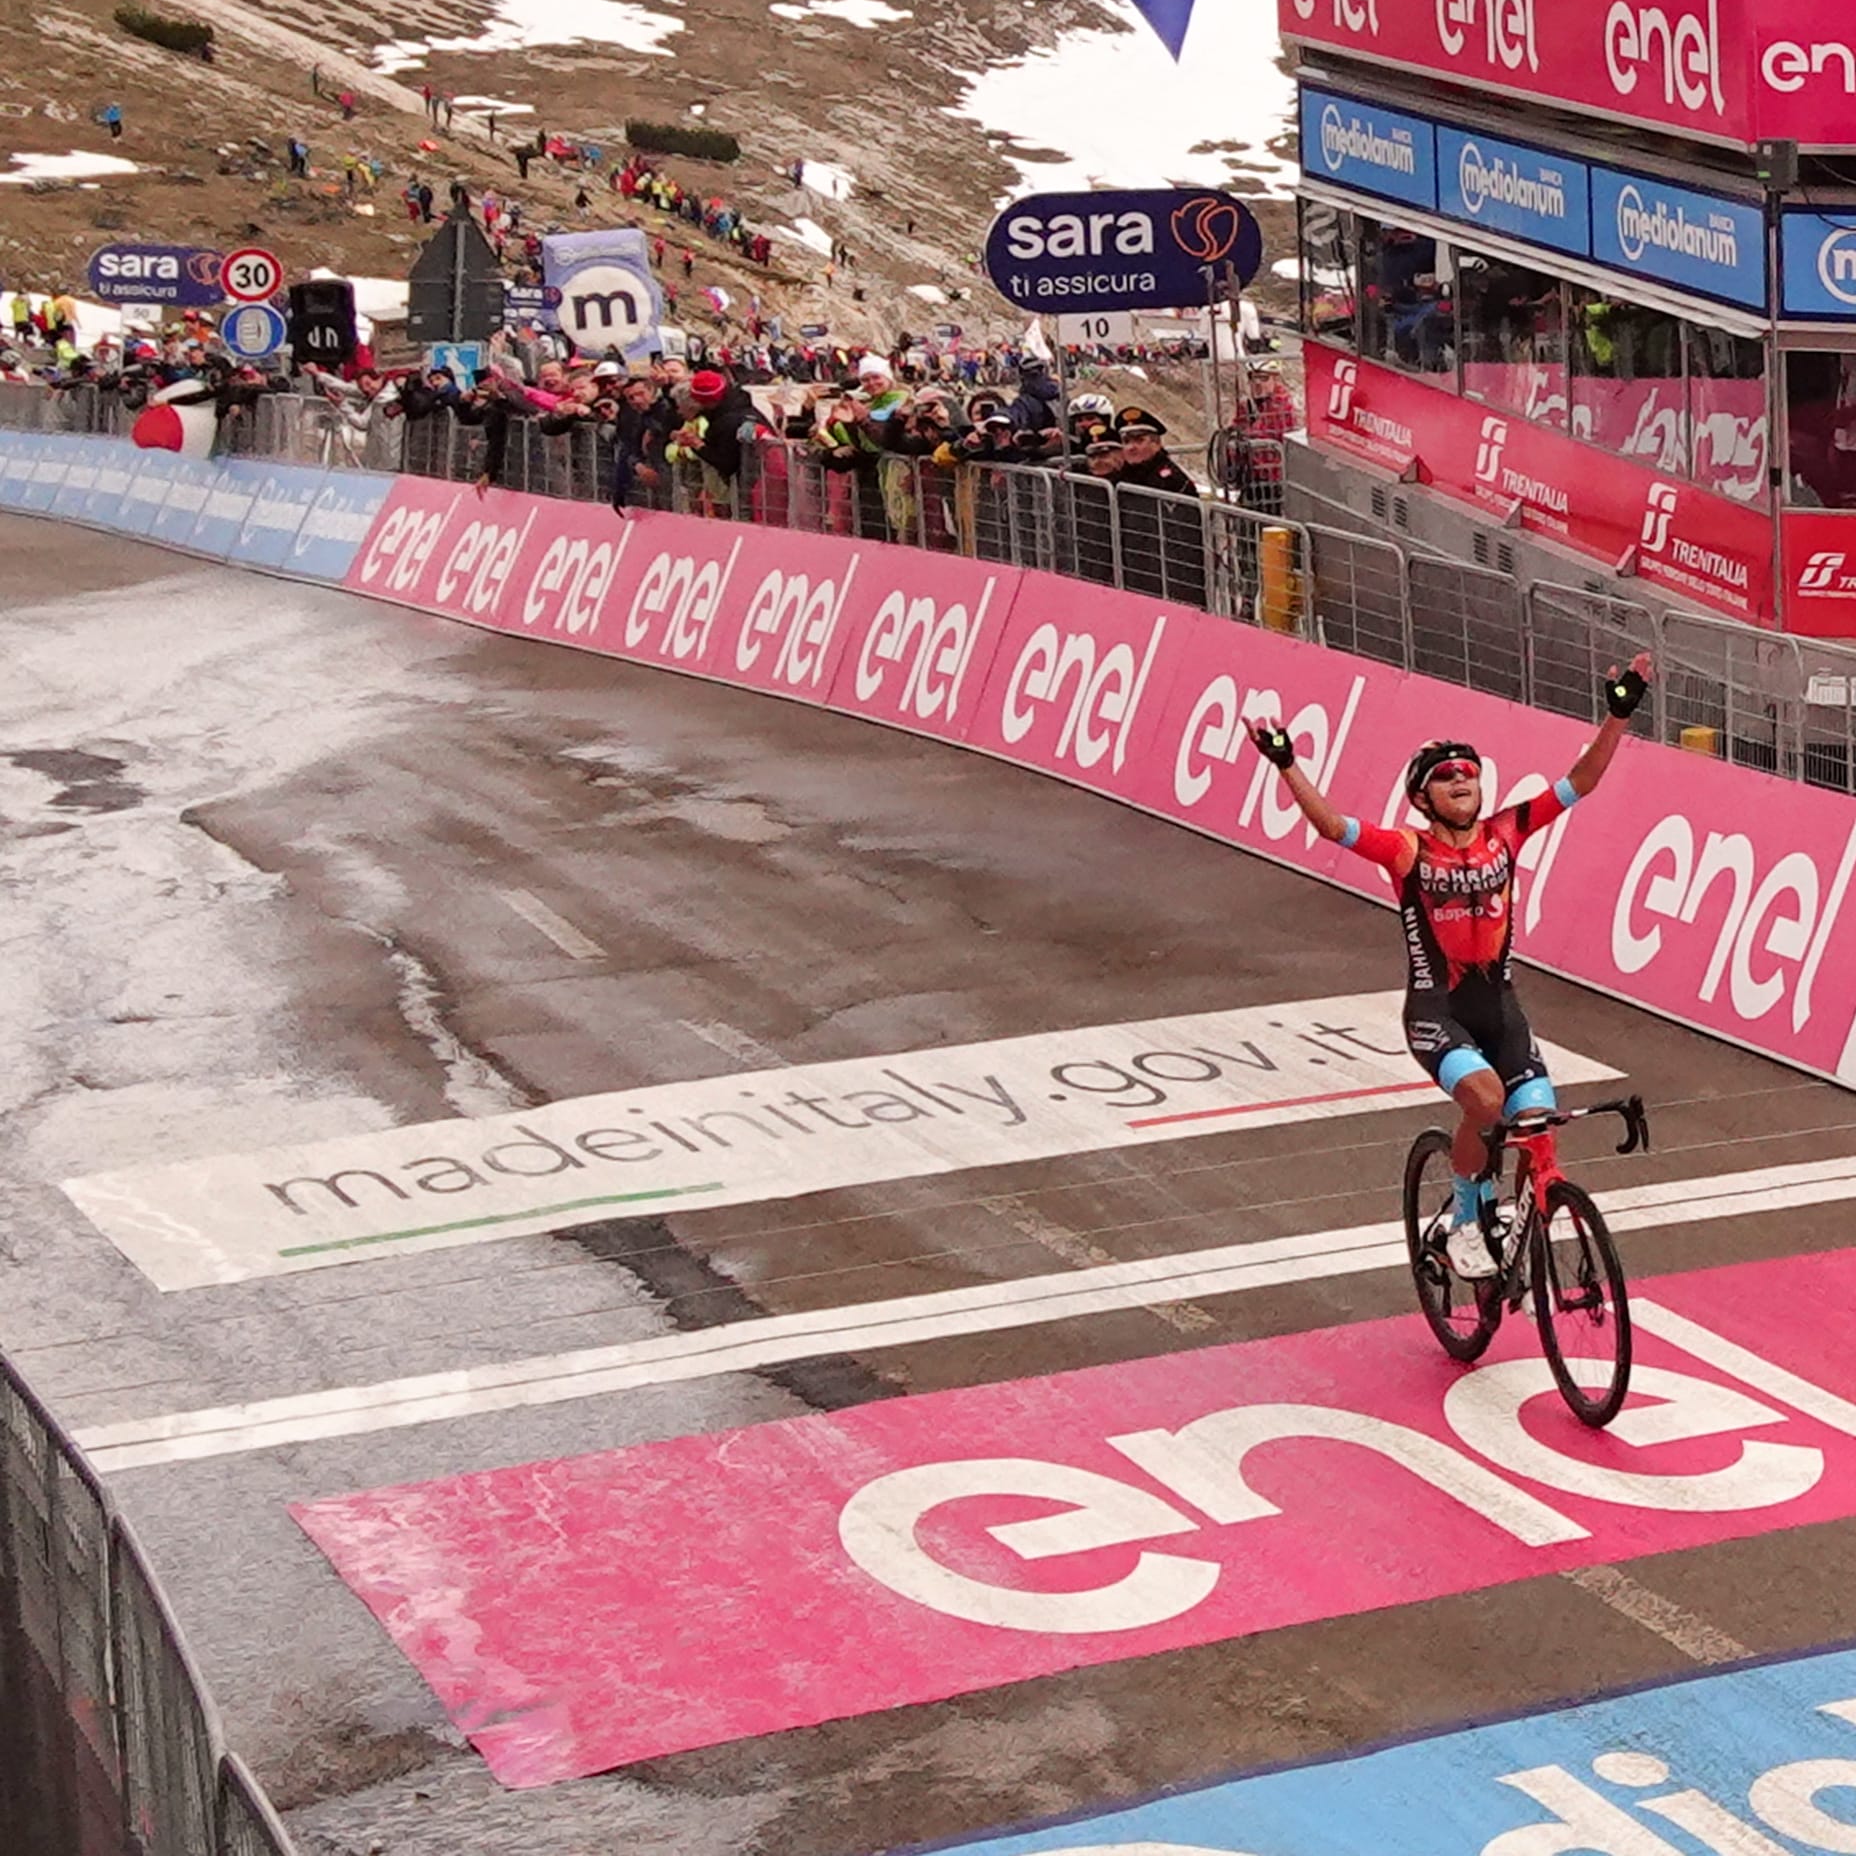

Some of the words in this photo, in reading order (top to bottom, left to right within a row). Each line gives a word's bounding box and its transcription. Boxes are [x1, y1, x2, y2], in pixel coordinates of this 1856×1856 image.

[1463, 156, 1565, 219] mediolanum
[1007, 209, 1155, 261] sara
[1622, 200, 1737, 268] mediolanum
[99, 252, 179, 279] sara
[234, 263, 270, 289] 30
[1010, 273, 1030, 298] ti
[1036, 271, 1156, 297] assicura
[1080, 318, 1110, 340] 10
[1502, 467, 1569, 517] TRENITALIA
[1672, 537, 1748, 590] TRENITALIA
[361, 493, 462, 592] enel
[435, 507, 538, 616] enel
[522, 520, 635, 637] enel
[624, 535, 743, 661] enel
[735, 553, 861, 689] enel
[854, 576, 996, 723] enel
[1001, 615, 1167, 776] enel
[1419, 848, 1508, 885] BAHRAIN
[1404, 905, 1434, 991] BAHRAIN
[263, 1016, 1405, 1218] madeinitaly.gov.it
